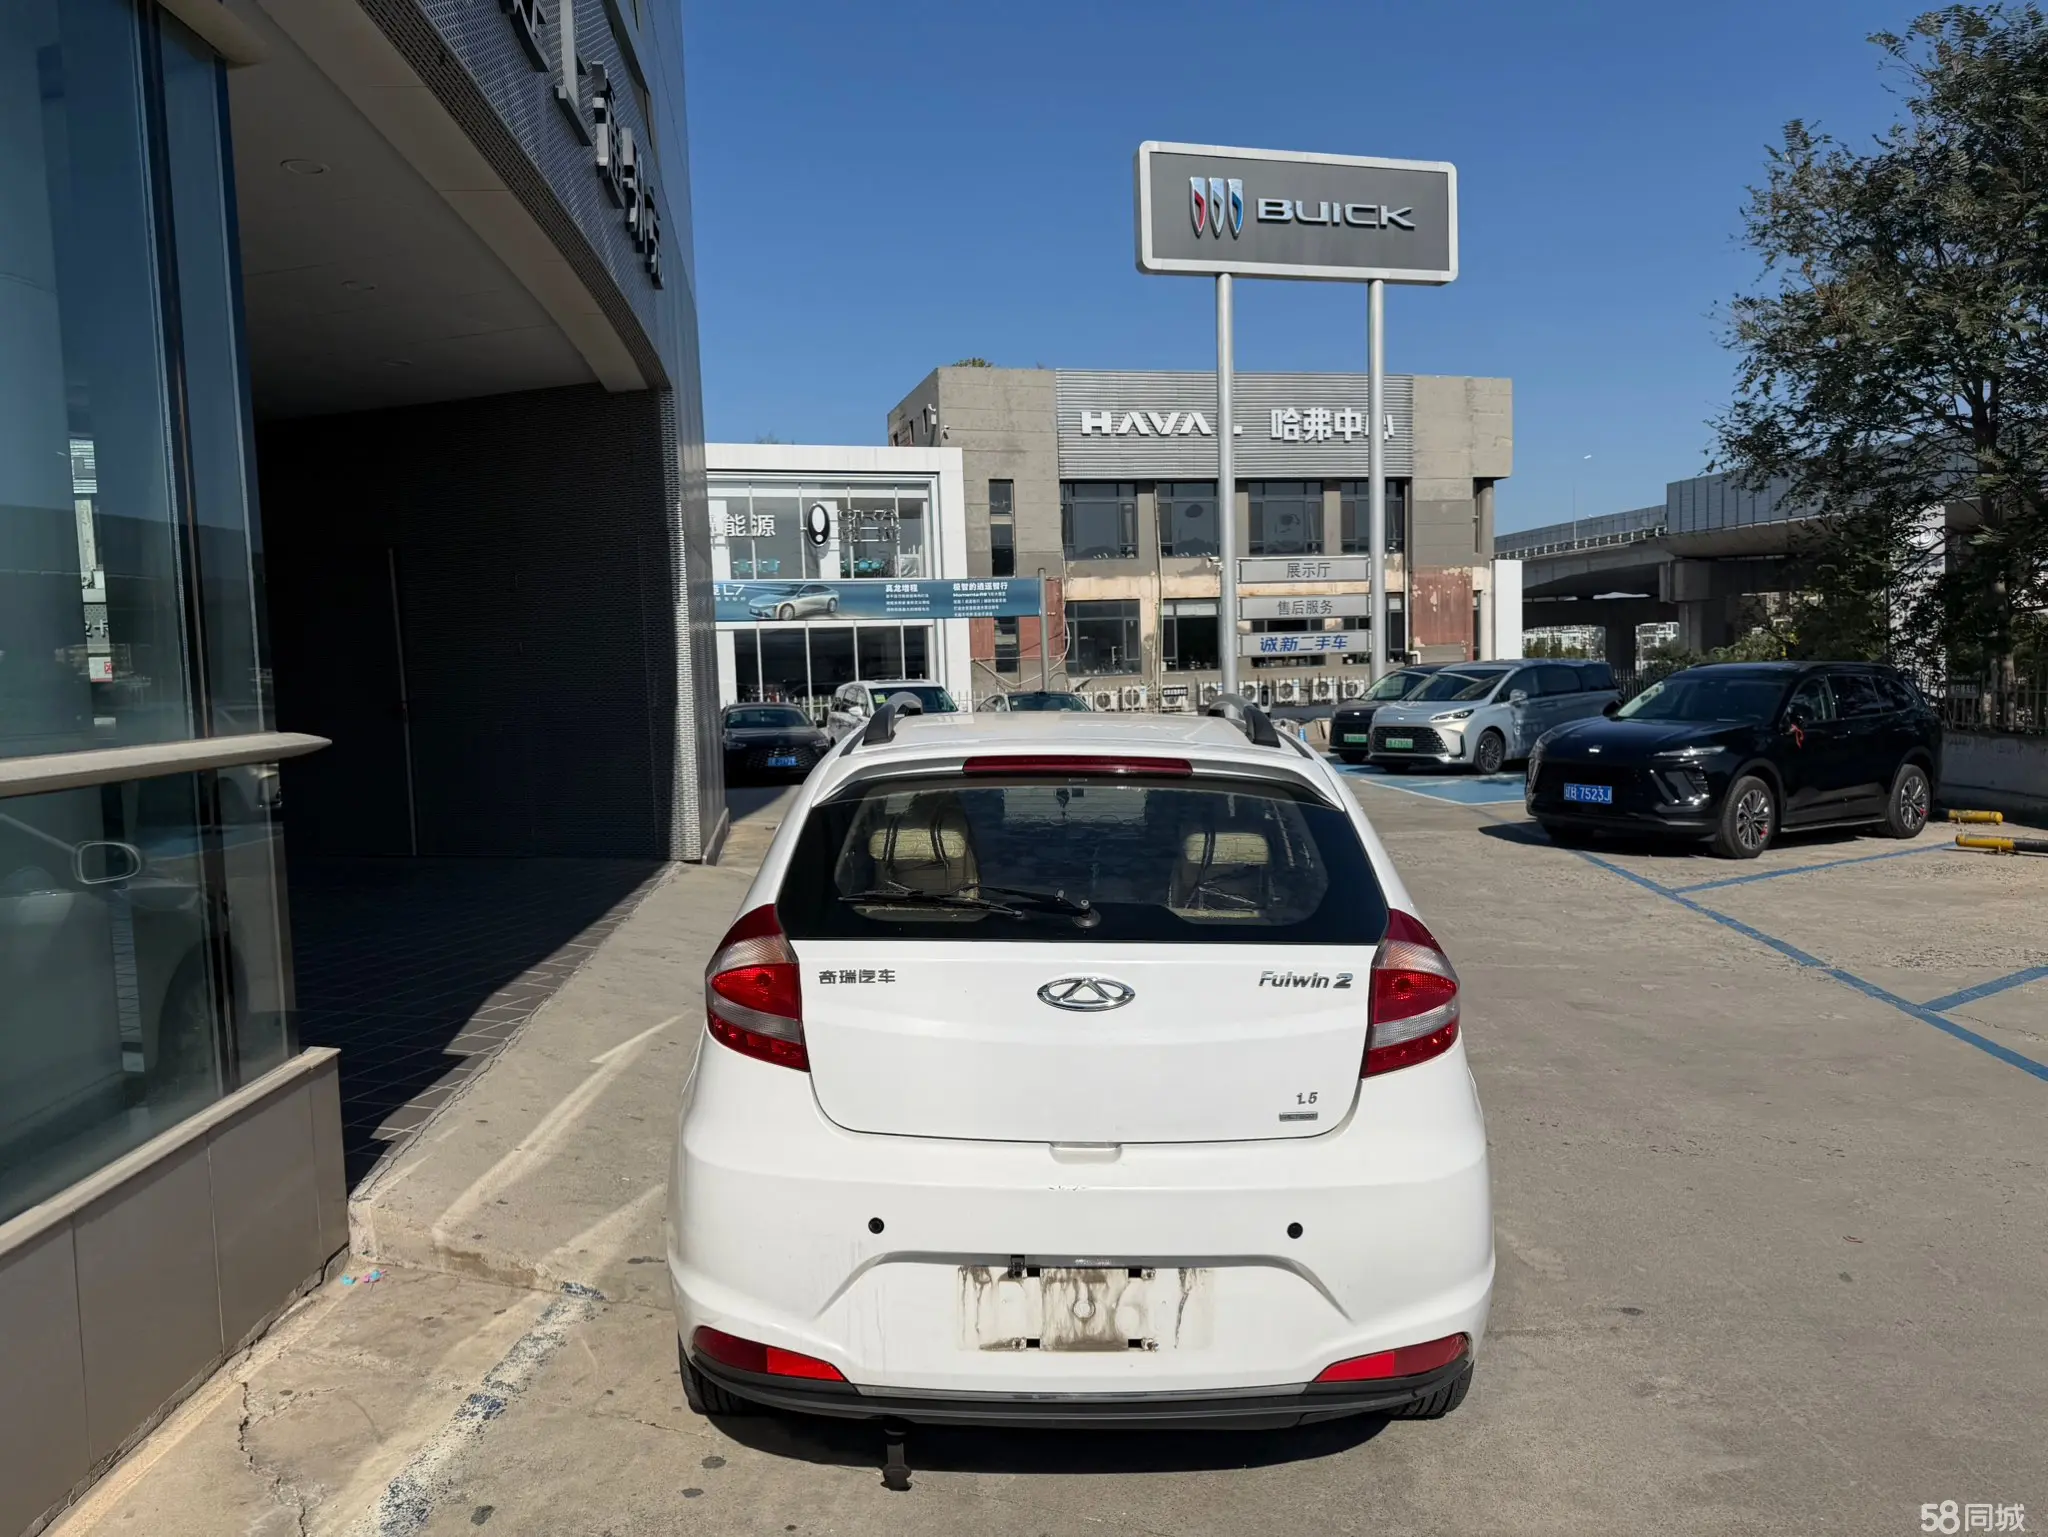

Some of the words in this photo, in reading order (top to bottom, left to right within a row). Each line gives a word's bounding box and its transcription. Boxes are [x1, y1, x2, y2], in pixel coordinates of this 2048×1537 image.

[1257, 198, 1416, 230] BUICK
[1286, 562, 1331, 578] 展示厅
[1277, 599, 1333, 616] 售后服务
[1259, 634, 1349, 653] 诚新二手车
[818, 968, 896, 985] 奇瑞汽车
[1332, 972, 1354, 989] 2
